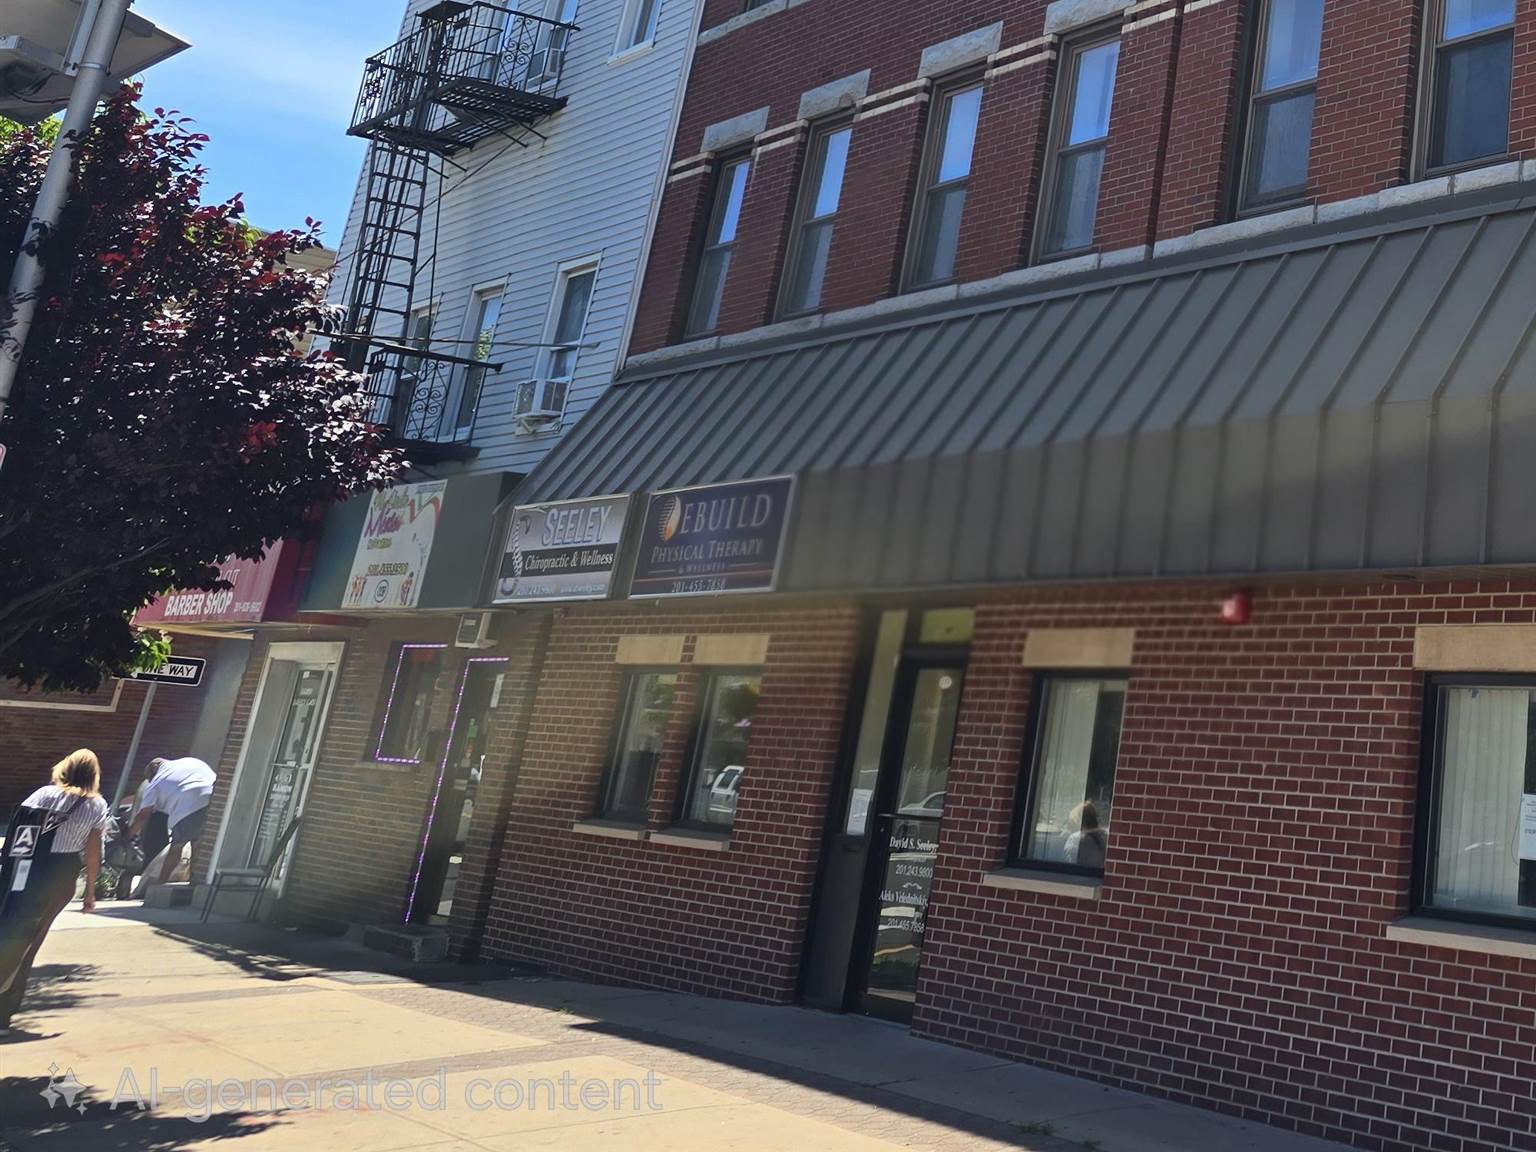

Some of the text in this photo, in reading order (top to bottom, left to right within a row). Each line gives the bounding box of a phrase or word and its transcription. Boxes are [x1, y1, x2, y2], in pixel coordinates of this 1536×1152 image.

[542, 505, 613, 546] SEELEY
[525, 549, 614, 572] Chiropractic & Wellness
[651, 537, 763, 563] PHYSICAL THERAPY
[164, 593, 205, 616] BARBER
[203, 591, 234, 615] SHOP
[169, 664, 194, 676] WAY
[889, 836, 908, 849] David
[909, 837, 915, 849] S.
